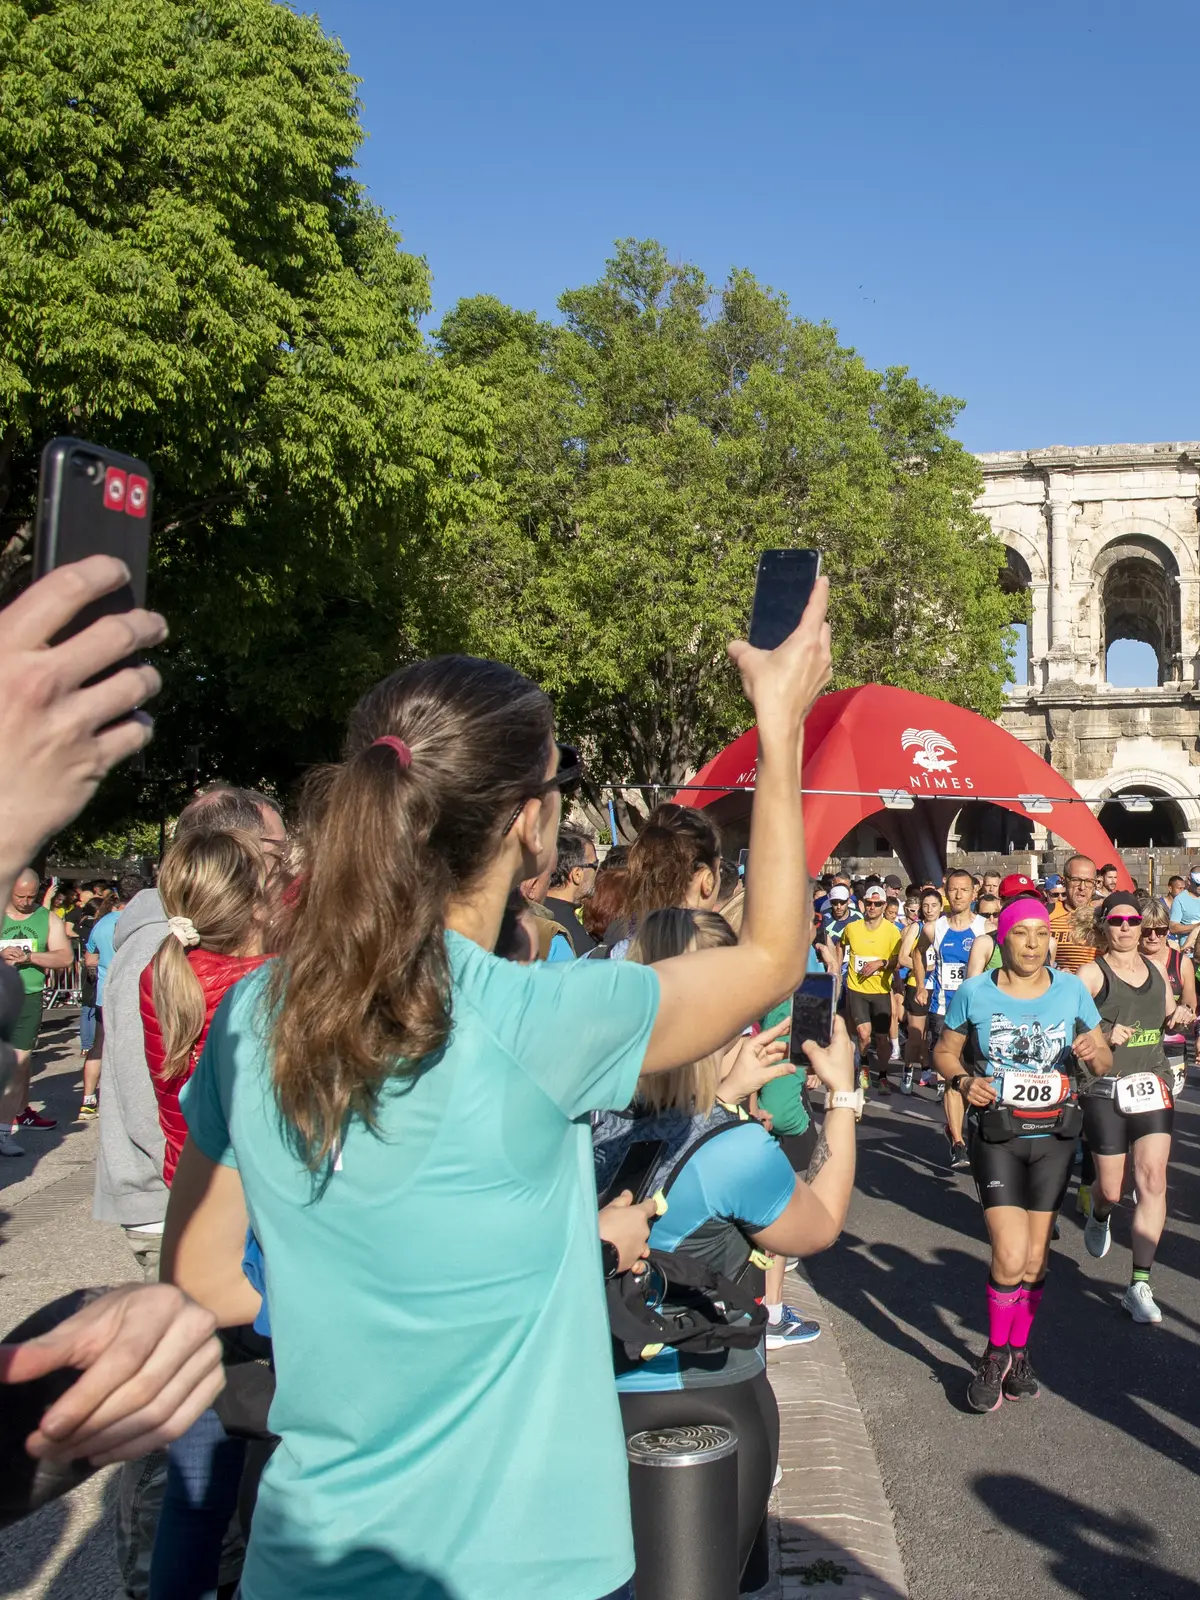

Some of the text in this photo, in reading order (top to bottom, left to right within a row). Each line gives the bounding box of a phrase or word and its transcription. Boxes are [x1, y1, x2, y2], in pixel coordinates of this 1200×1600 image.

[909, 772, 975, 789] NÎMES
[950, 969, 965, 980] 58
[1012, 1084, 1052, 1102] 208
[1126, 1081, 1155, 1098] 183
